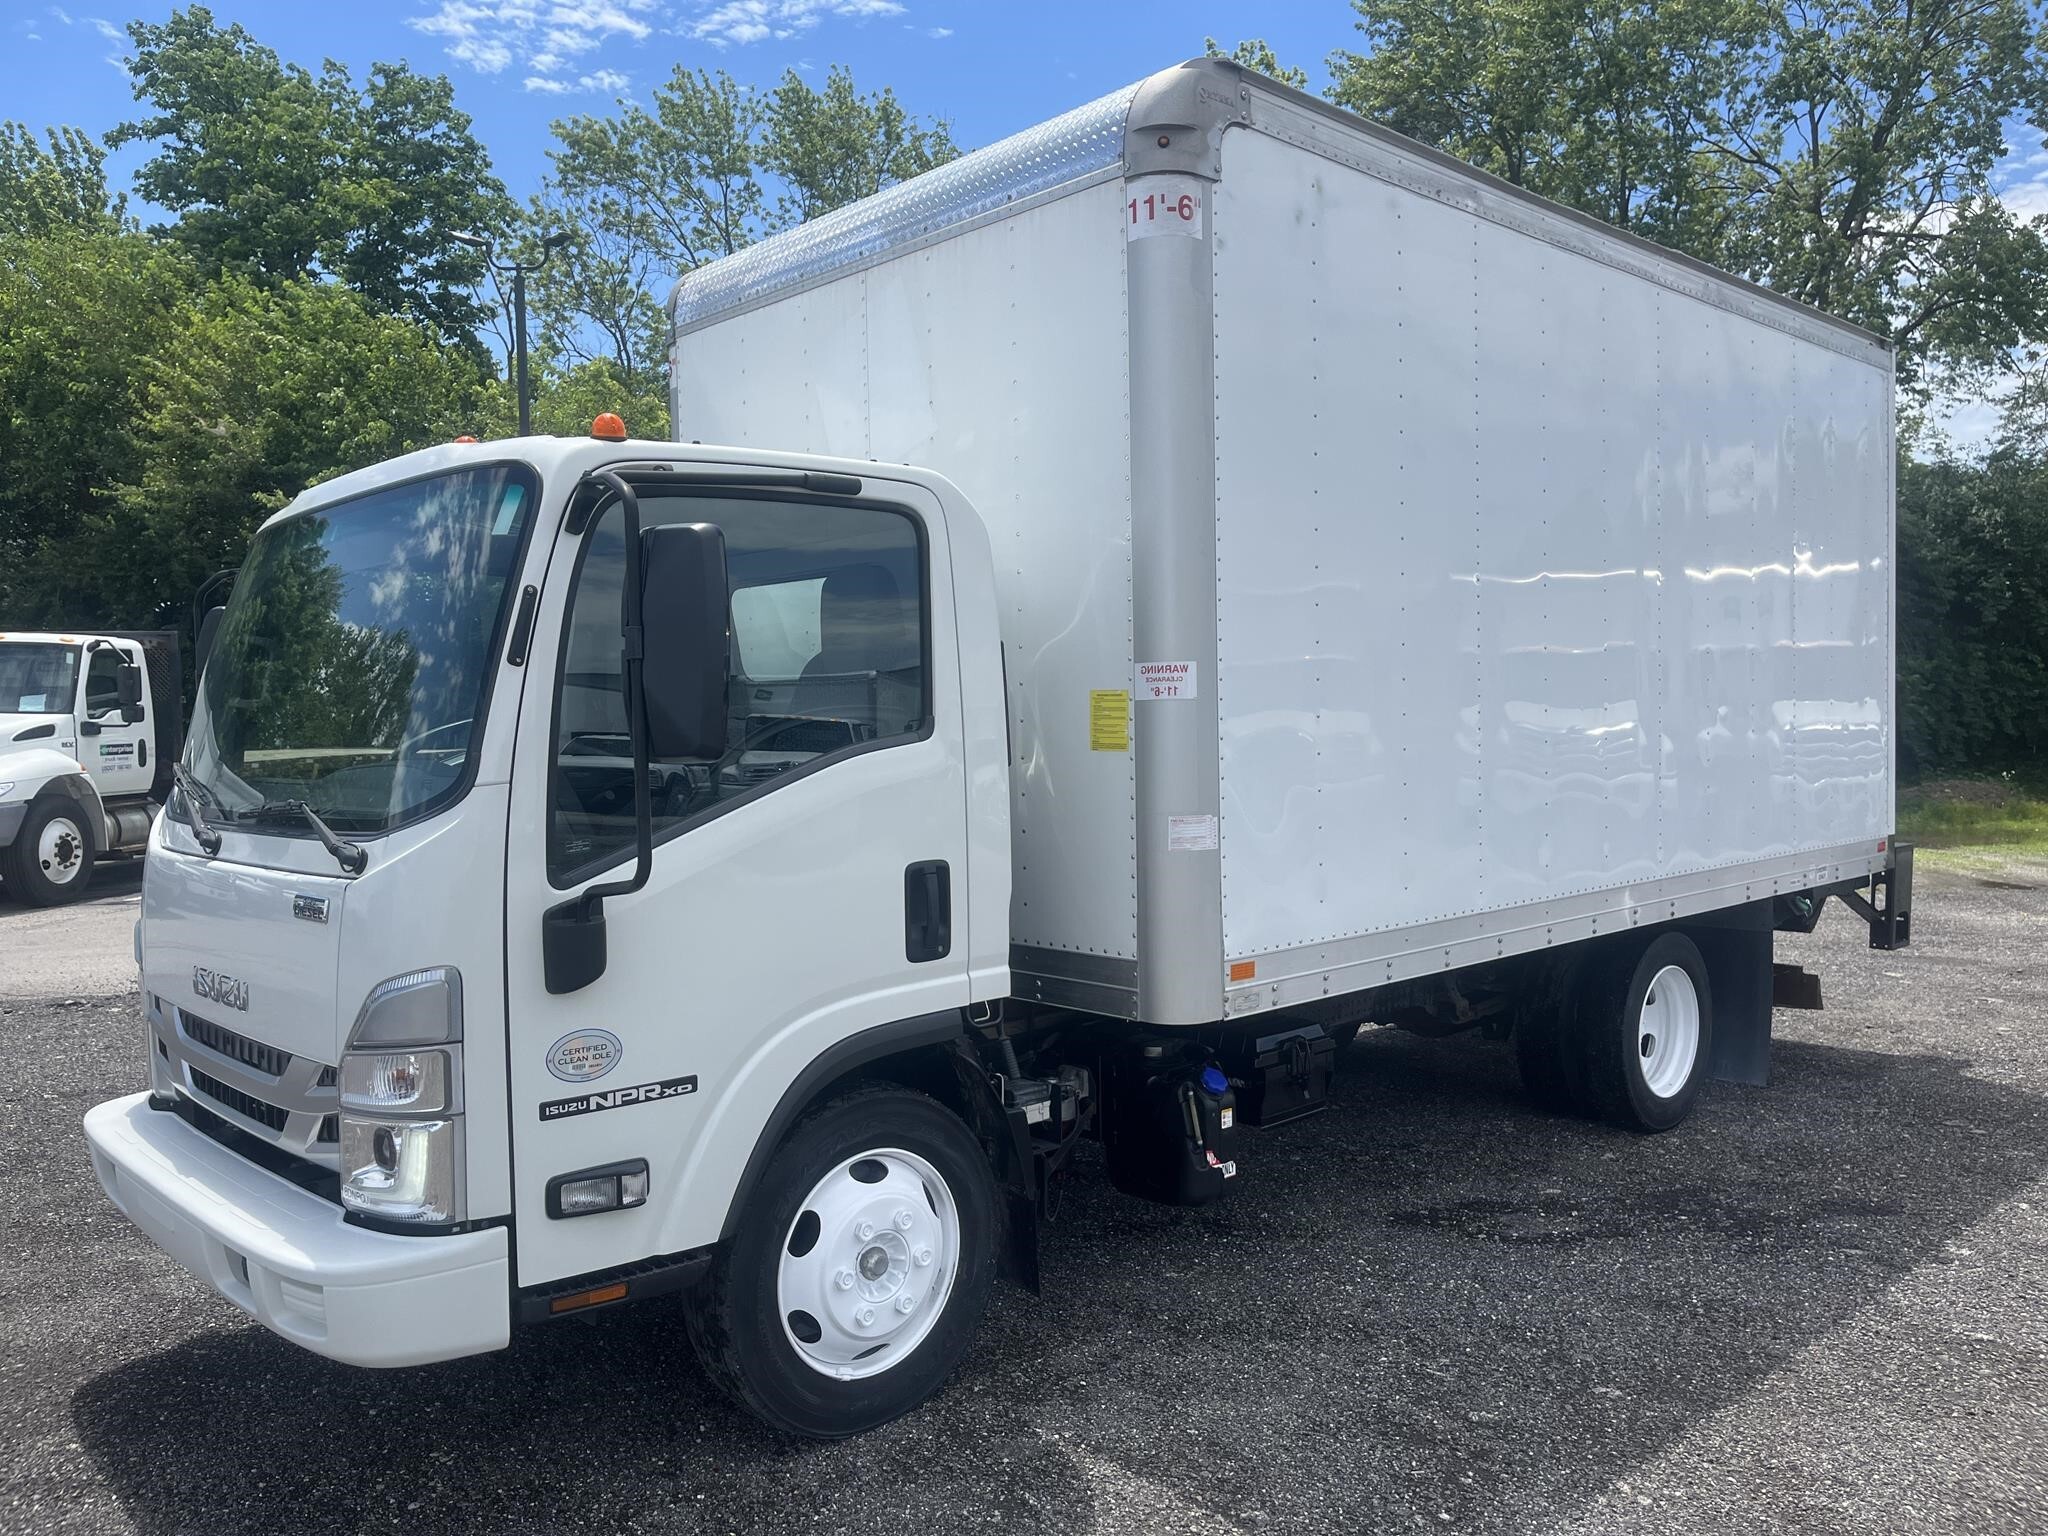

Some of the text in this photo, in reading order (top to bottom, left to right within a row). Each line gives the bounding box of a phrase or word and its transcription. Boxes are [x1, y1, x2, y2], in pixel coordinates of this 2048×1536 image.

[193, 965, 249, 1012] ISUZU
[562, 1043, 608, 1056] CERTIFIED
[557, 1051, 612, 1066] CLEAN IDLE
[545, 1100, 587, 1116] ISUZU
